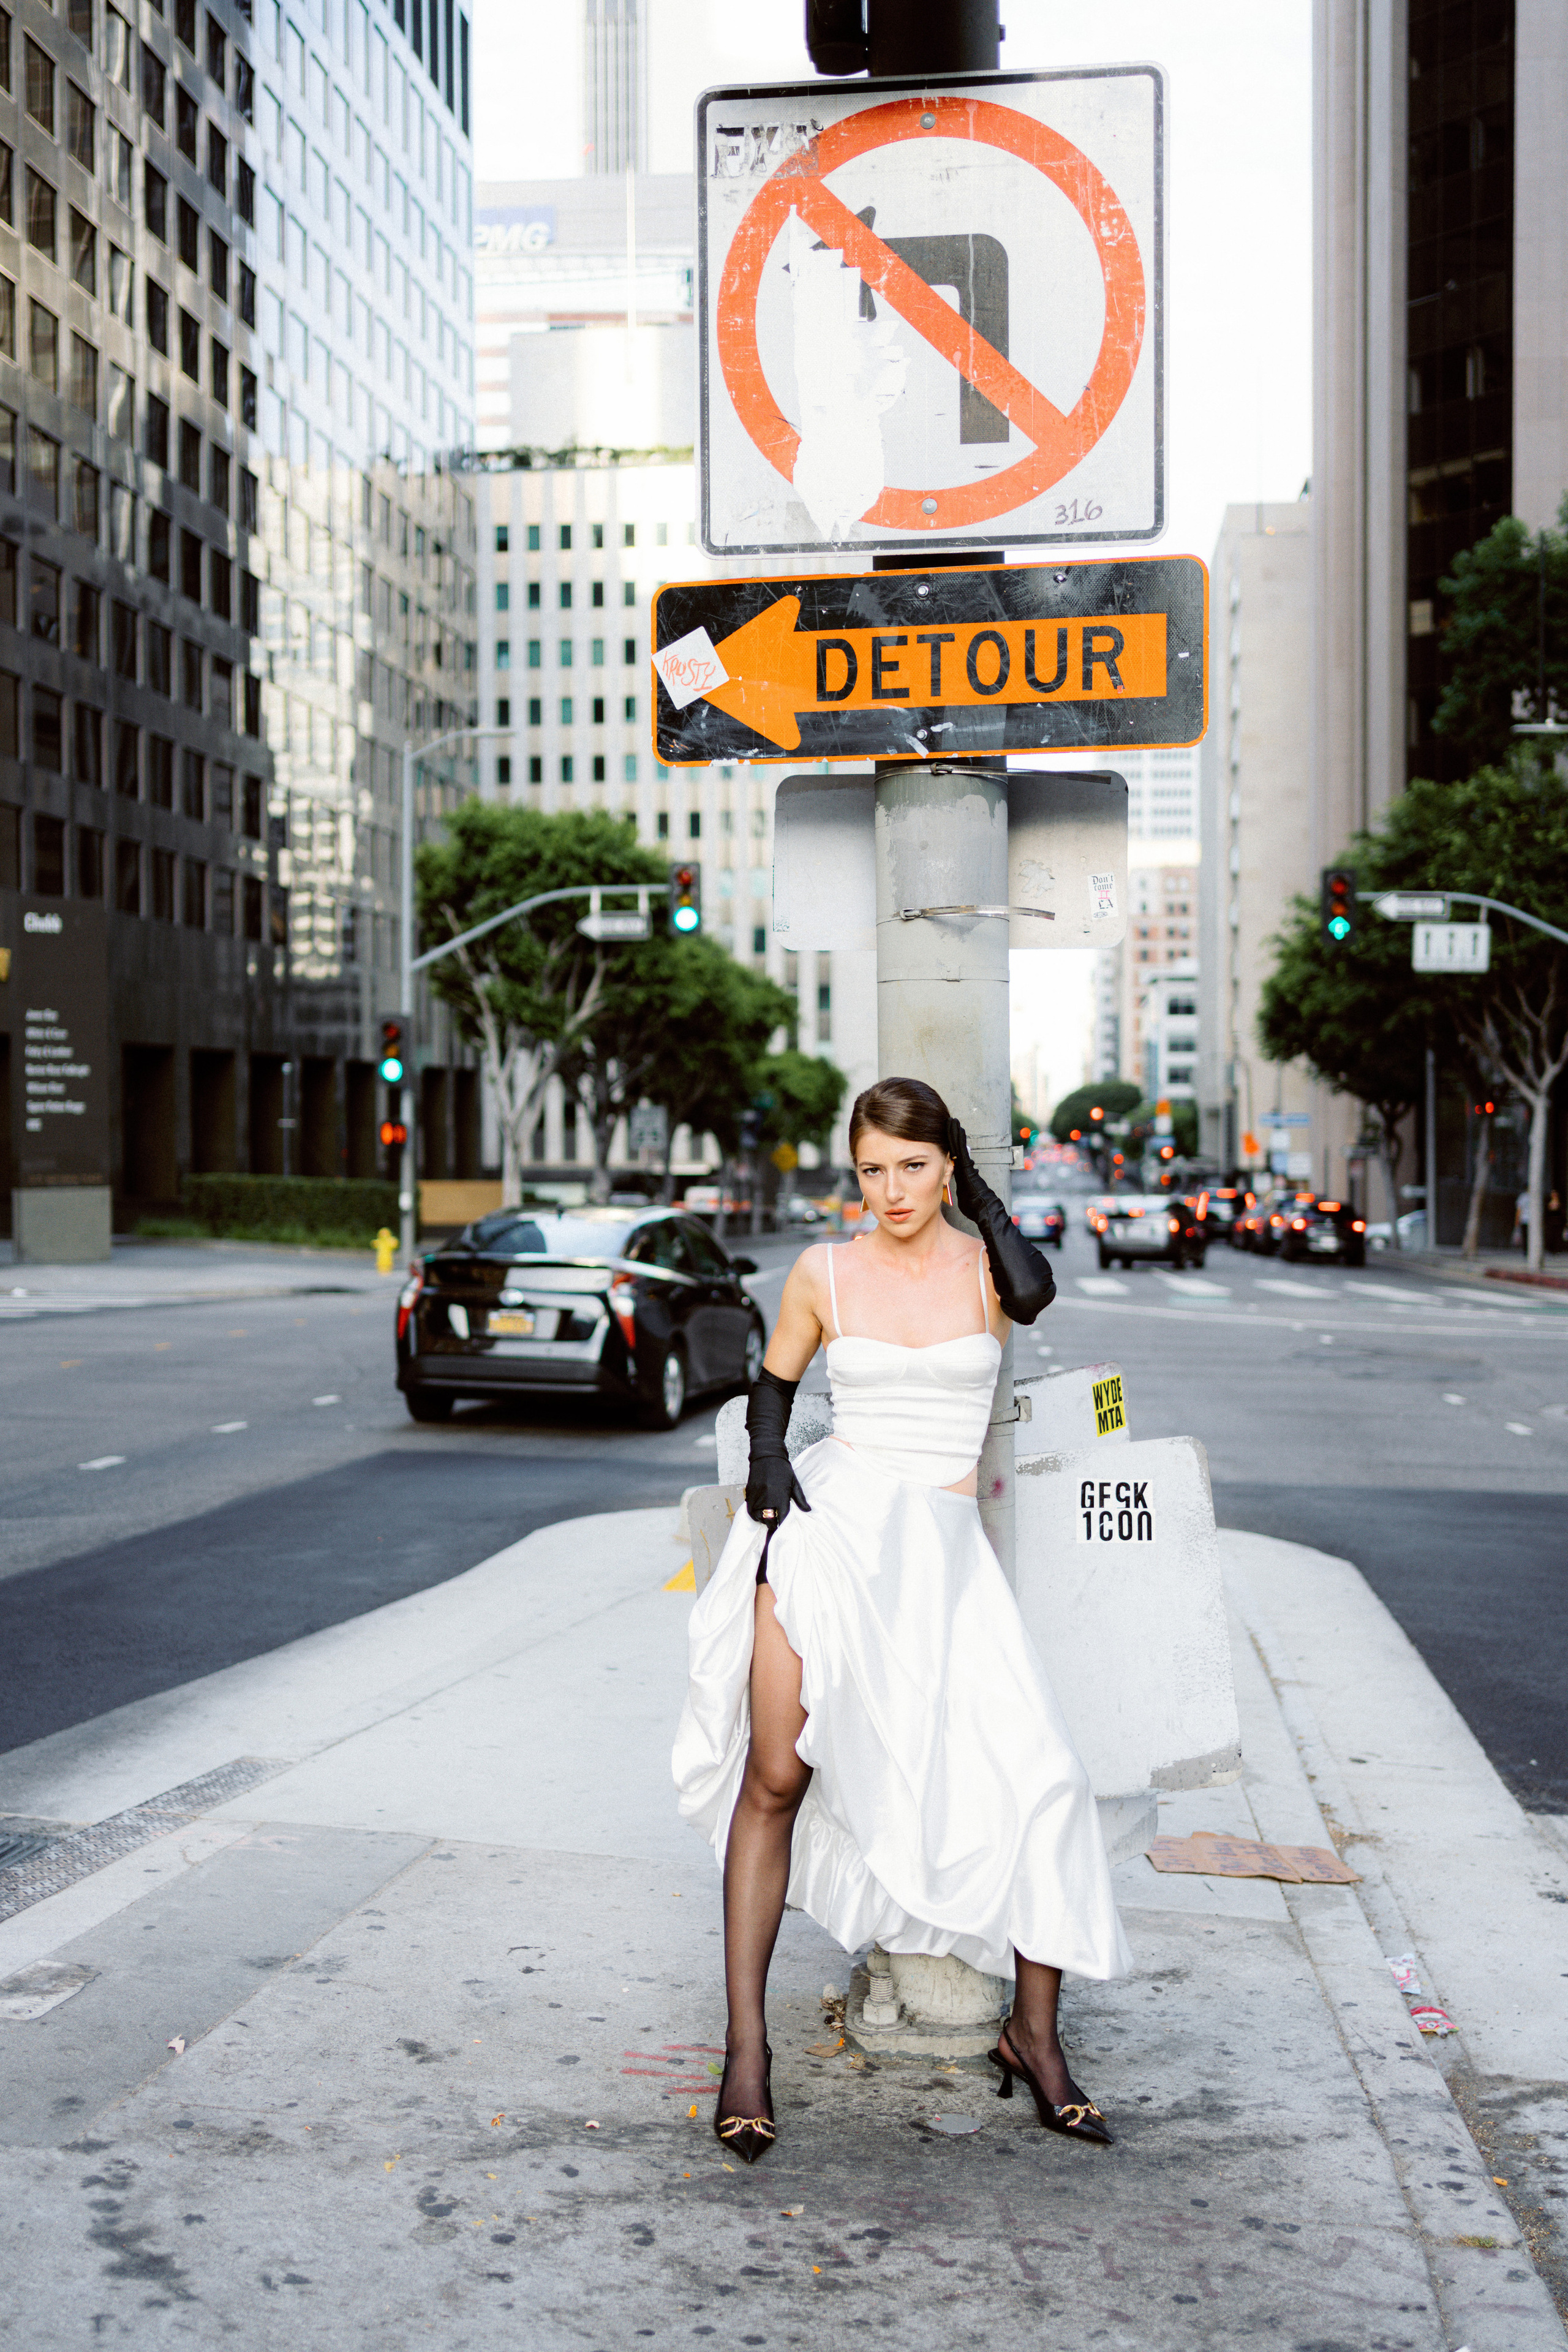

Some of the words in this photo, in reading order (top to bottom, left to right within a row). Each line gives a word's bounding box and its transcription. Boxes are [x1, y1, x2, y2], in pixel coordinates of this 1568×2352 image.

[472, 221, 551, 252] PMG
[1055, 499, 1102, 526] 316
[662, 650, 716, 692] KRUSTY
[816, 625, 1126, 703] DETOUR
[1091, 874, 1114, 885] Don't
[1093, 1377, 1123, 1411] WYDE
[1098, 1405, 1123, 1434] MTA
